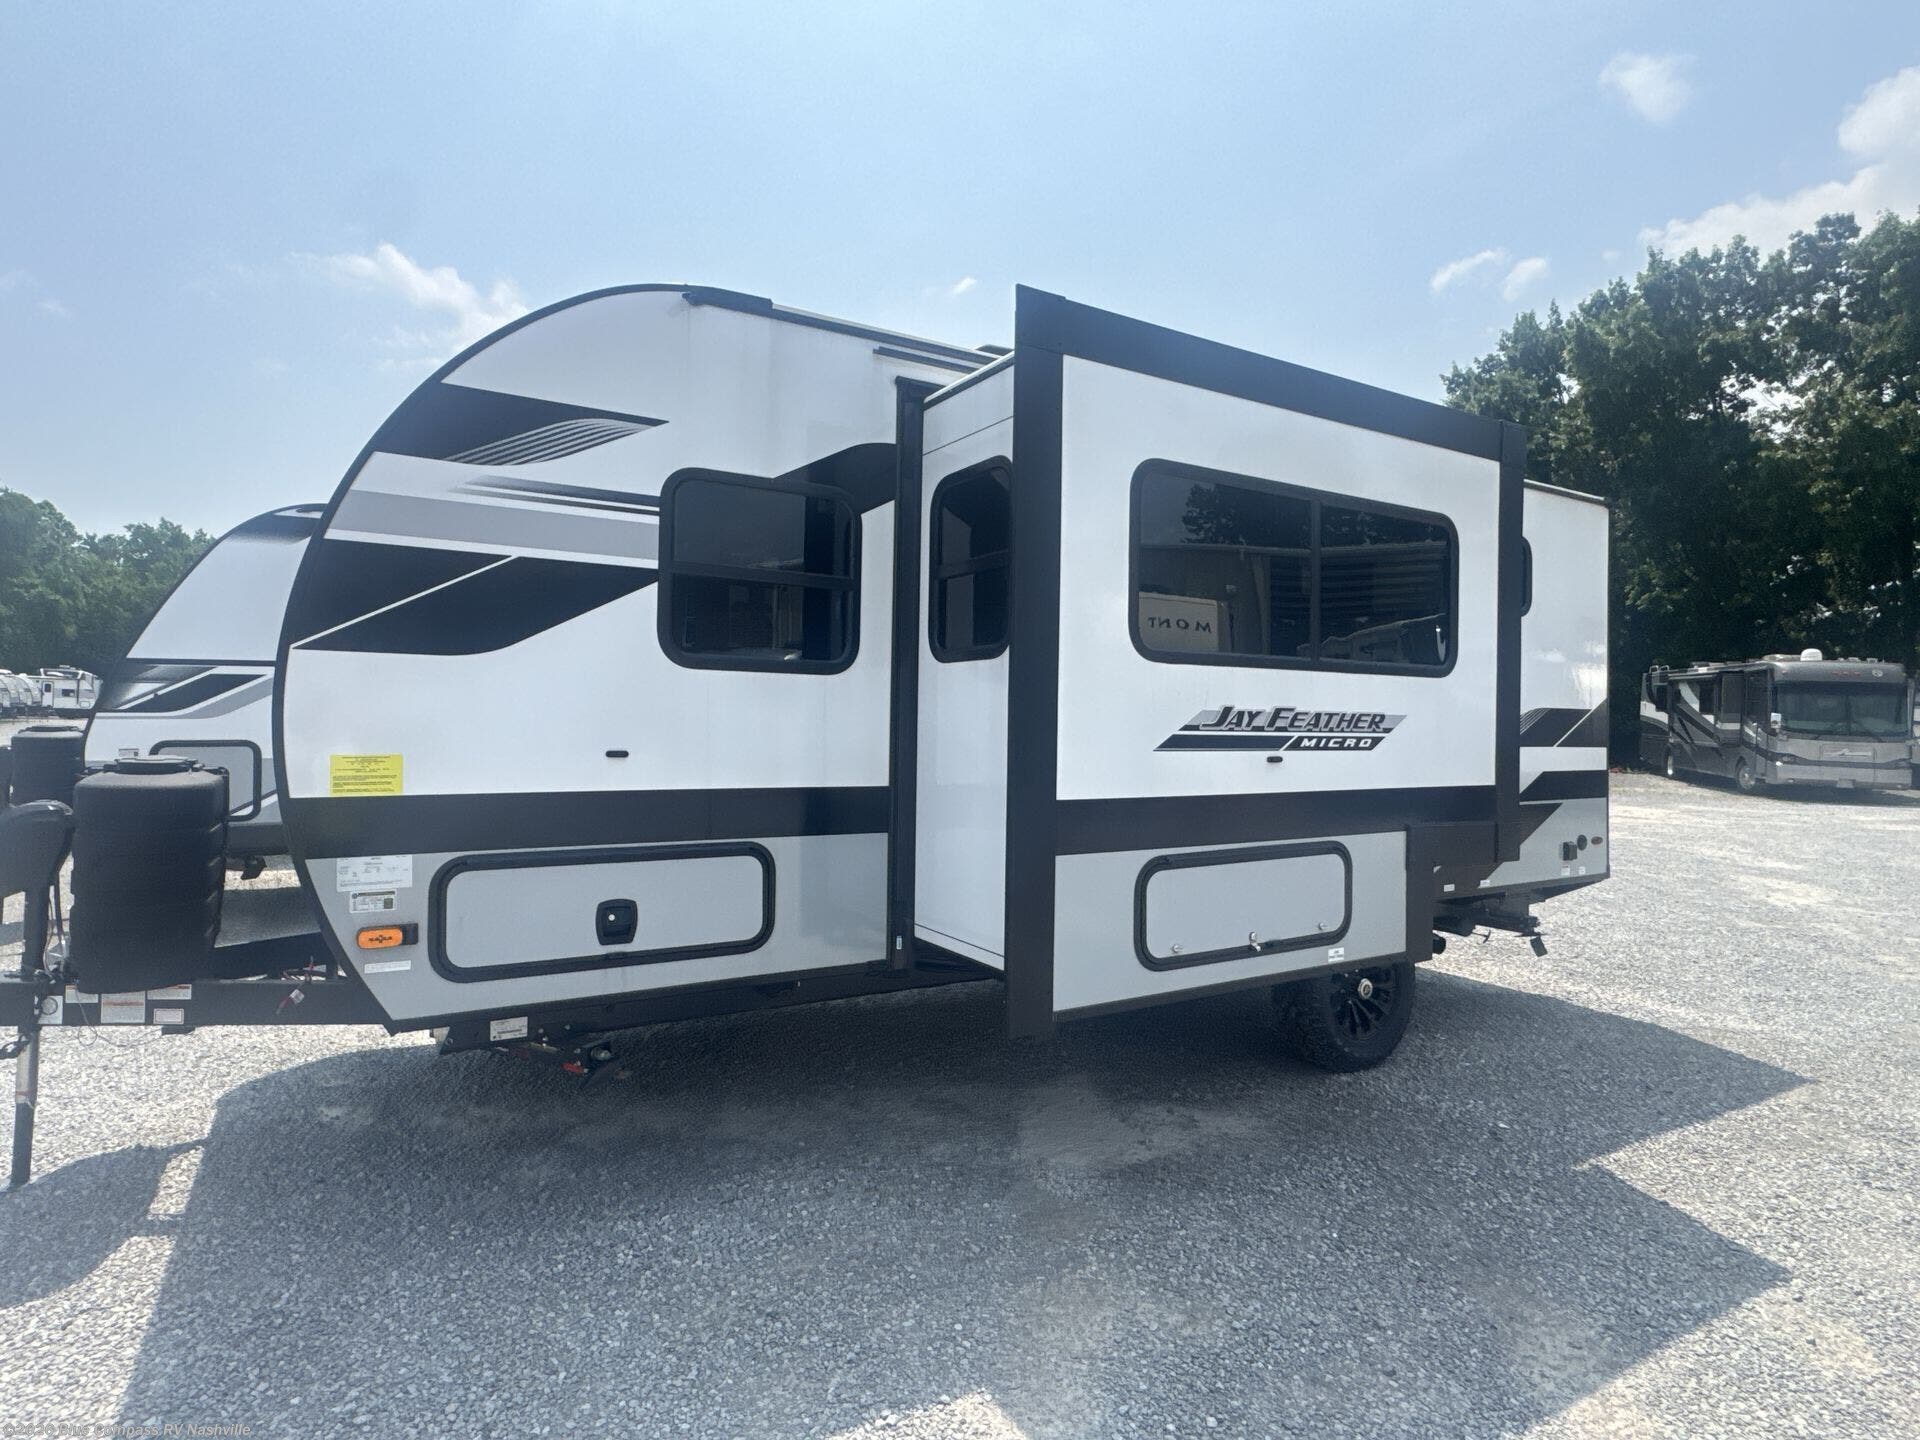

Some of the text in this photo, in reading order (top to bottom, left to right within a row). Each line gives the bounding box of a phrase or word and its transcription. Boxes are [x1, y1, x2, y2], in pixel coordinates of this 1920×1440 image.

[1200, 705, 1387, 732] JAY FEATHER
[1300, 736, 1372, 748] MICRO
